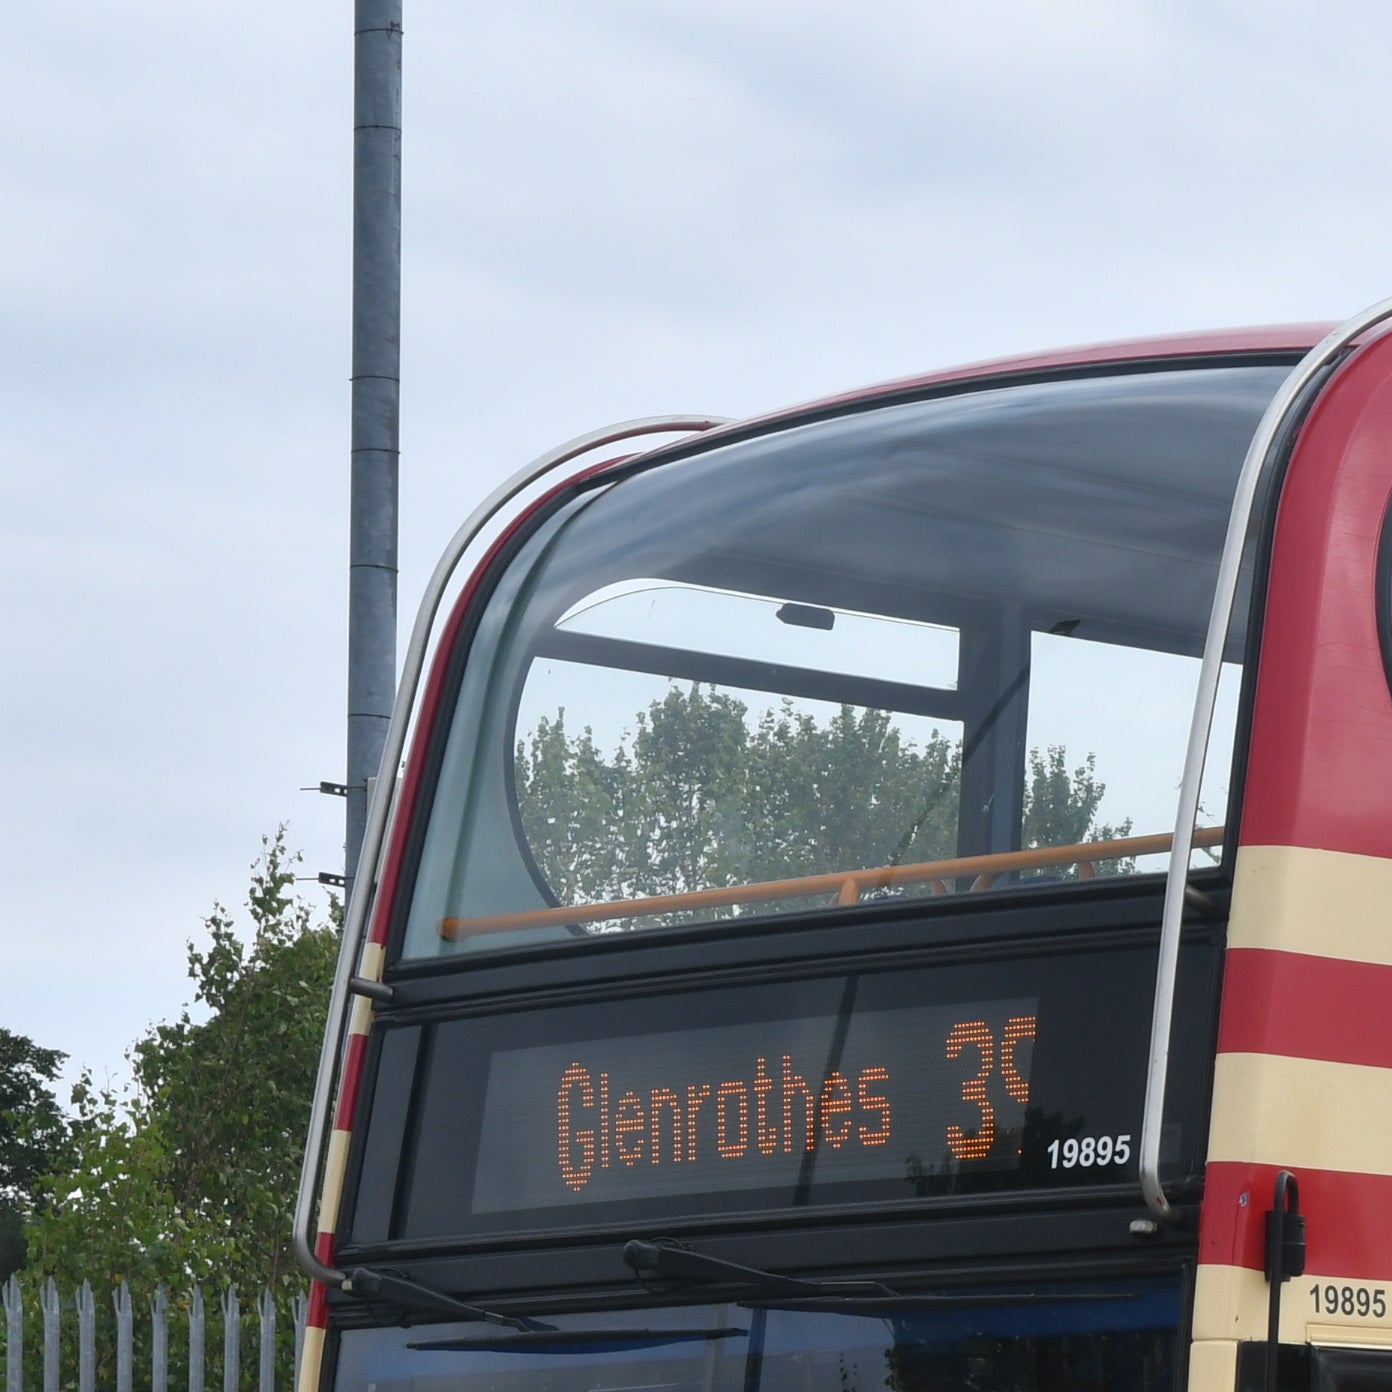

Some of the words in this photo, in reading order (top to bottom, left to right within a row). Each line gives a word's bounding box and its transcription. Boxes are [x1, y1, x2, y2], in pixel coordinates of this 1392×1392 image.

[557, 1055, 891, 1191] Glenrothes
[1046, 1134, 1131, 1169] 19895
[1309, 1283, 1386, 1318] 19895
